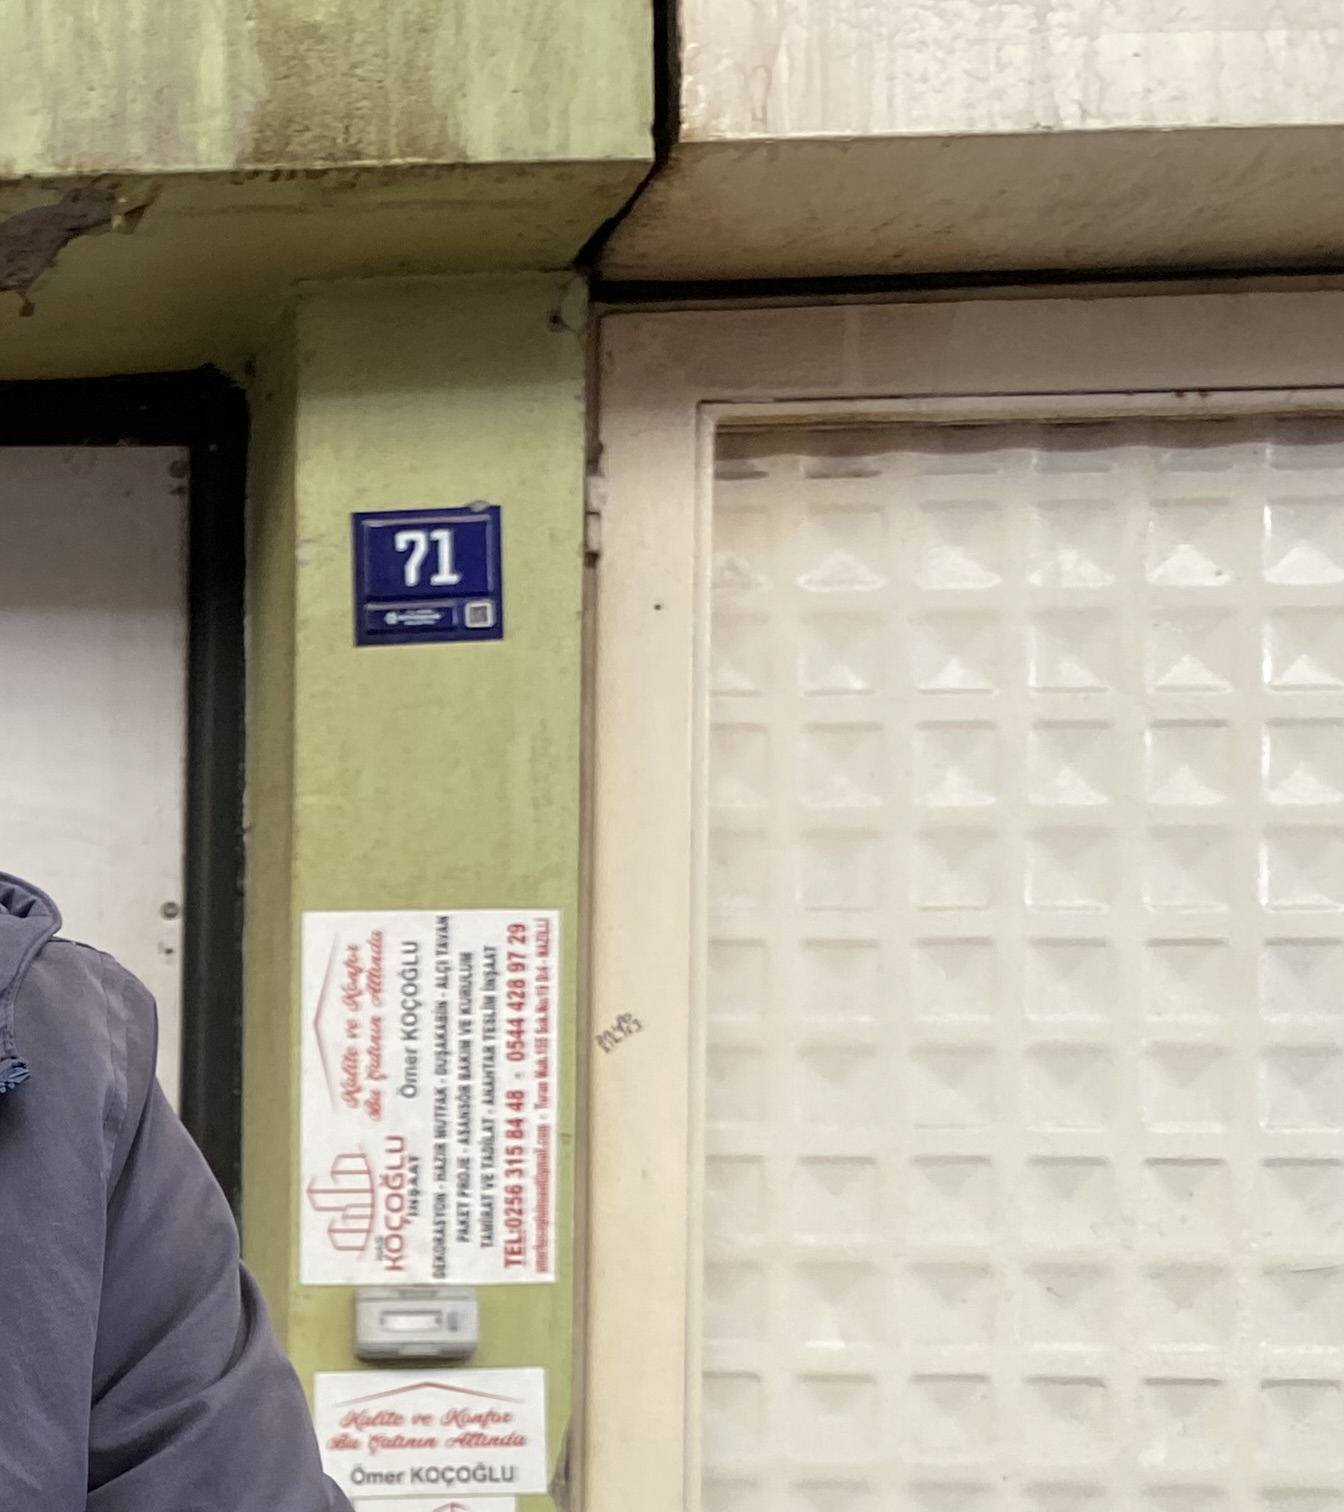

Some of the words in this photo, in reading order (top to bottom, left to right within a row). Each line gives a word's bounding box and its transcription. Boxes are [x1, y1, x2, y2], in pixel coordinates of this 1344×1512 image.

[394, 527, 461, 587] 71
[507, 923, 525, 945] 29
[507, 952, 525, 972] 97
[398, 941, 421, 1041] KOÇOĞLU
[506, 979, 525, 1011] 428
[506, 1018, 525, 1062] 0544
[396, 1047, 418, 1099] Ömer
[506, 1090, 524, 1111] 48
[506, 1118, 524, 1139] 84
[505, 1146, 524, 1178] 315
[379, 1136, 411, 1270] KOÇOĞLU
[350, 1465, 404, 1485] Ömer
[410, 1465, 515, 1486] KOÇOĞLU
